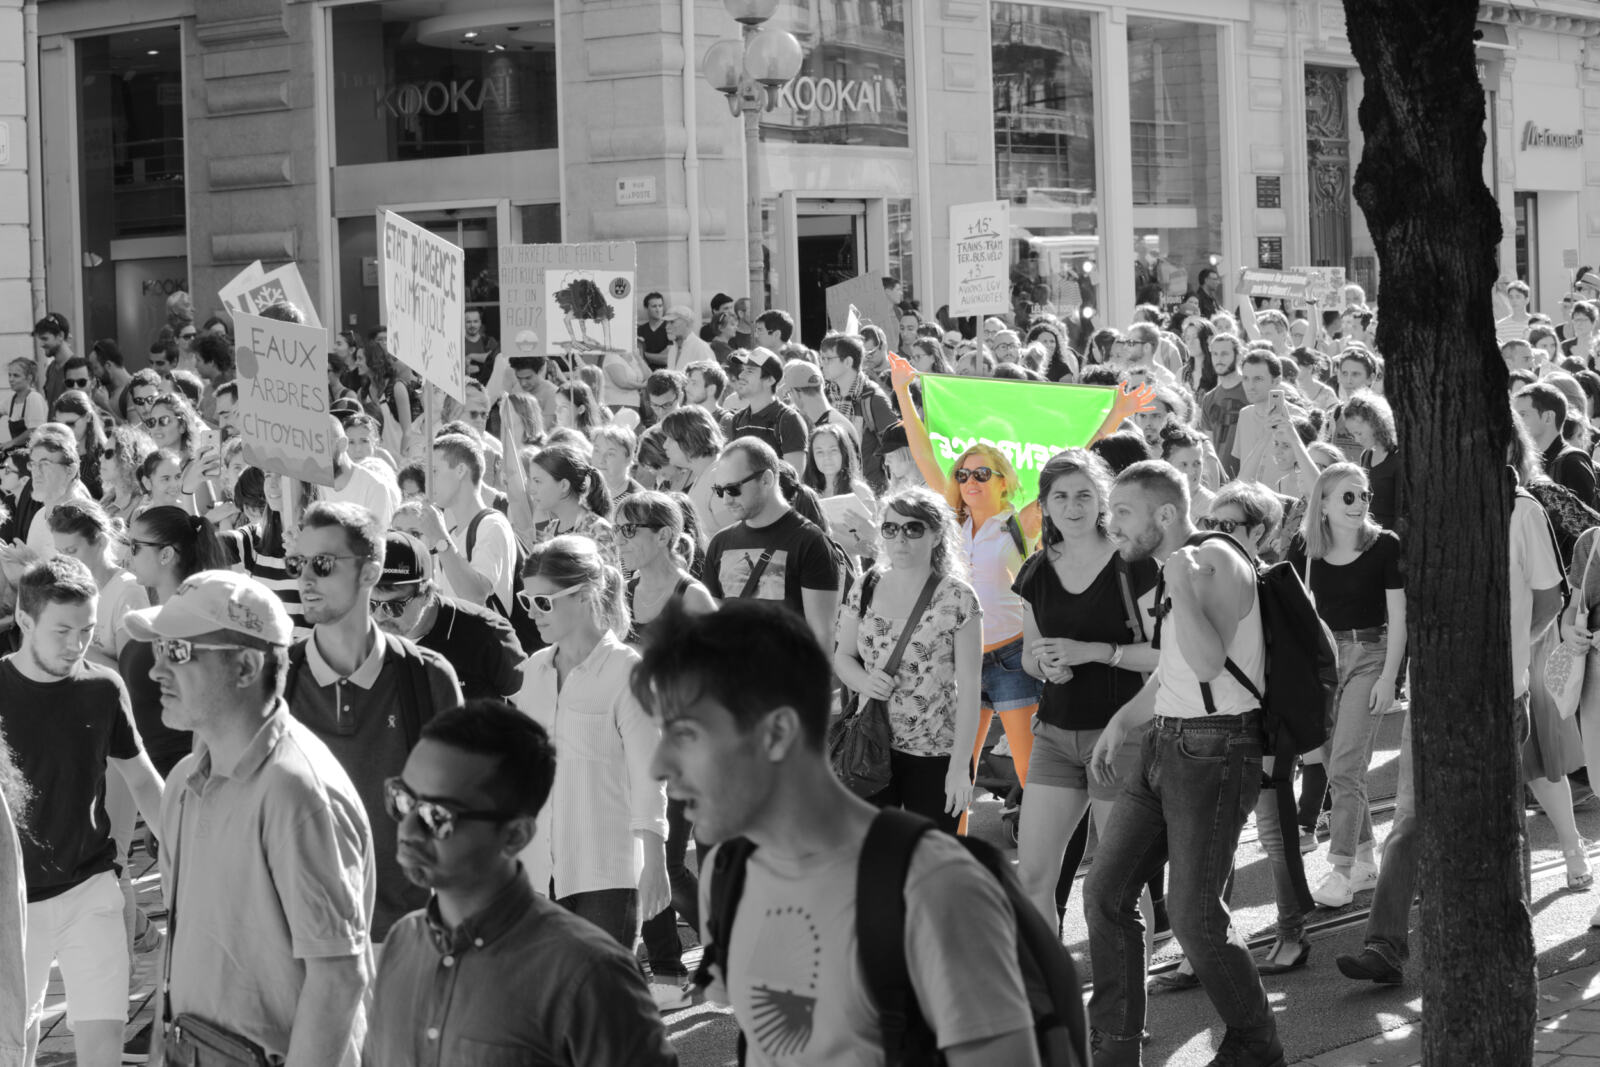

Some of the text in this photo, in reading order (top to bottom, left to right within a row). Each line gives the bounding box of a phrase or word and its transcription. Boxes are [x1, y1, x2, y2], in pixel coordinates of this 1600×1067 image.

[777, 75, 883, 113] KOOKAÏ
[141, 277, 188, 297] KOOK
[251, 327, 317, 371] EAUX
[250, 375, 325, 413] ARBRES
